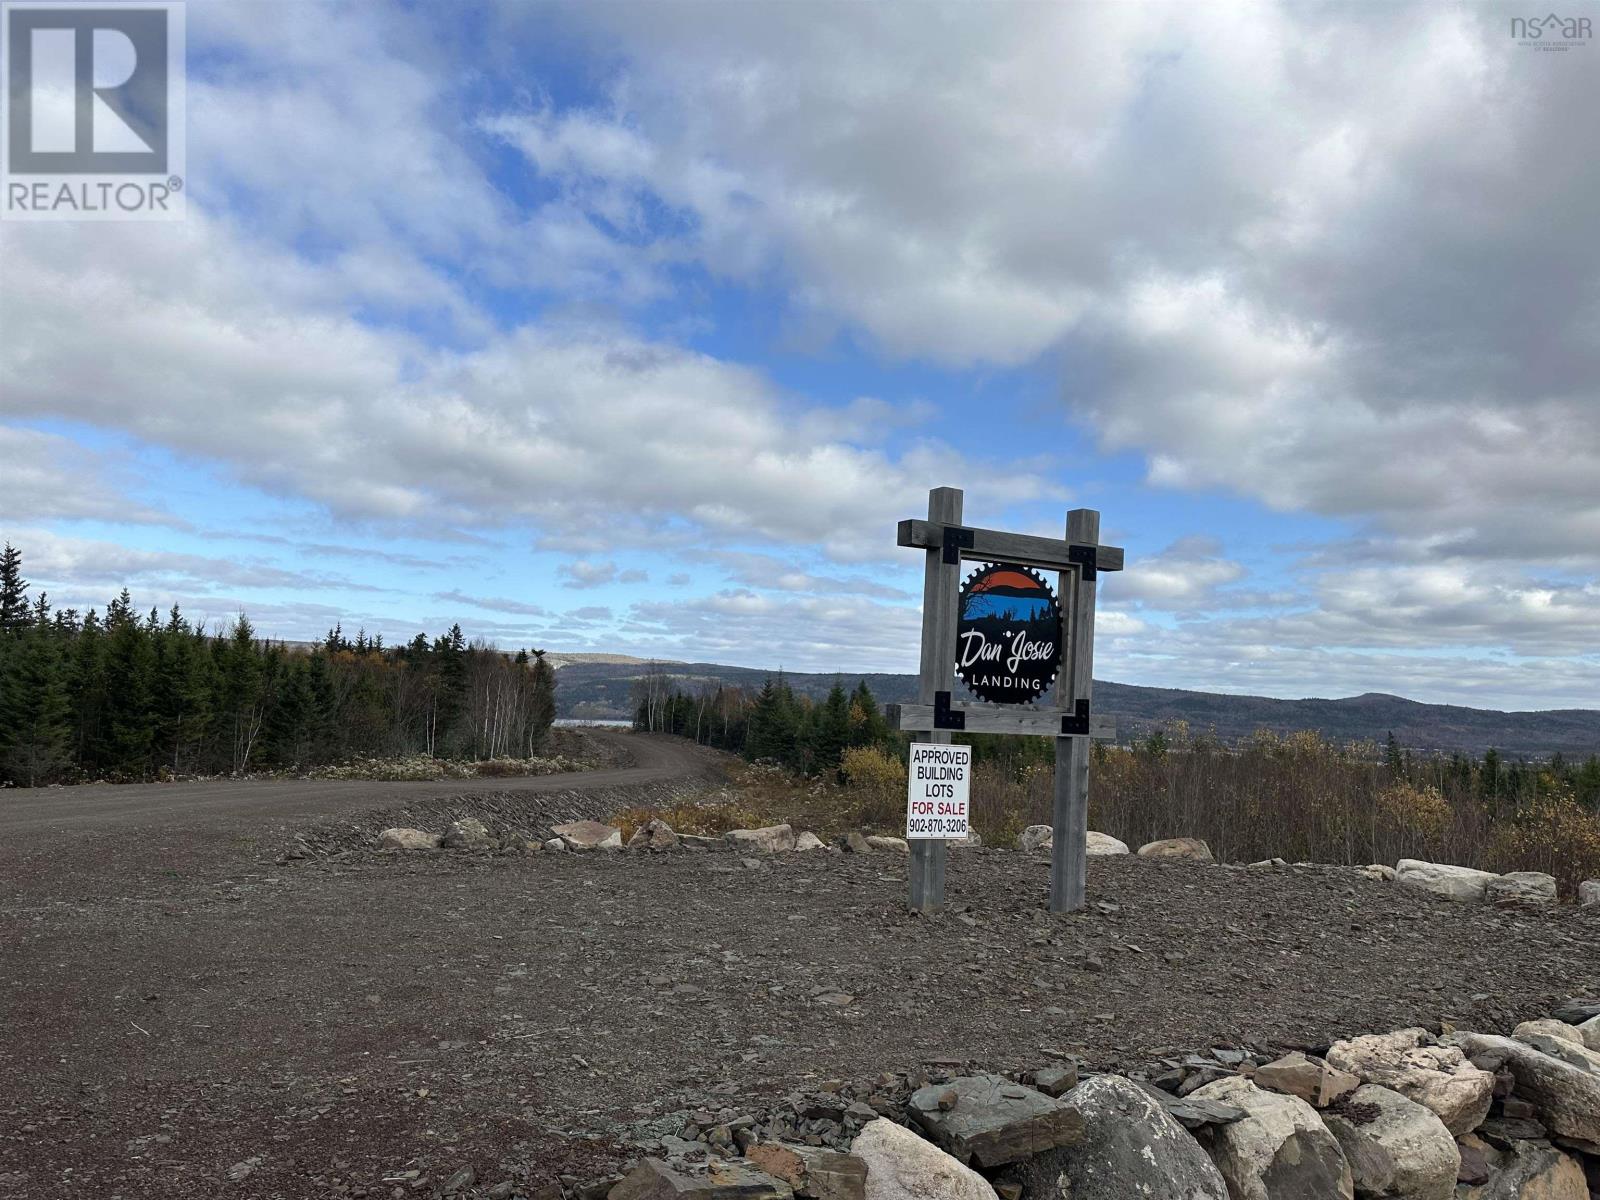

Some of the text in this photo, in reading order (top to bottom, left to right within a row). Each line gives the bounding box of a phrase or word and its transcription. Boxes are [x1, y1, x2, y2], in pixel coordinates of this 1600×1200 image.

[960, 627, 1055, 674] Dan Josie
[972, 674, 1041, 690] LANDING
[913, 749, 969, 765] APPROVED
[917, 766, 963, 781] BUILDING
[925, 784, 954, 798] LOTS
[912, 802, 966, 816] FOR SALE
[909, 818, 967, 833] 902-870-3206
